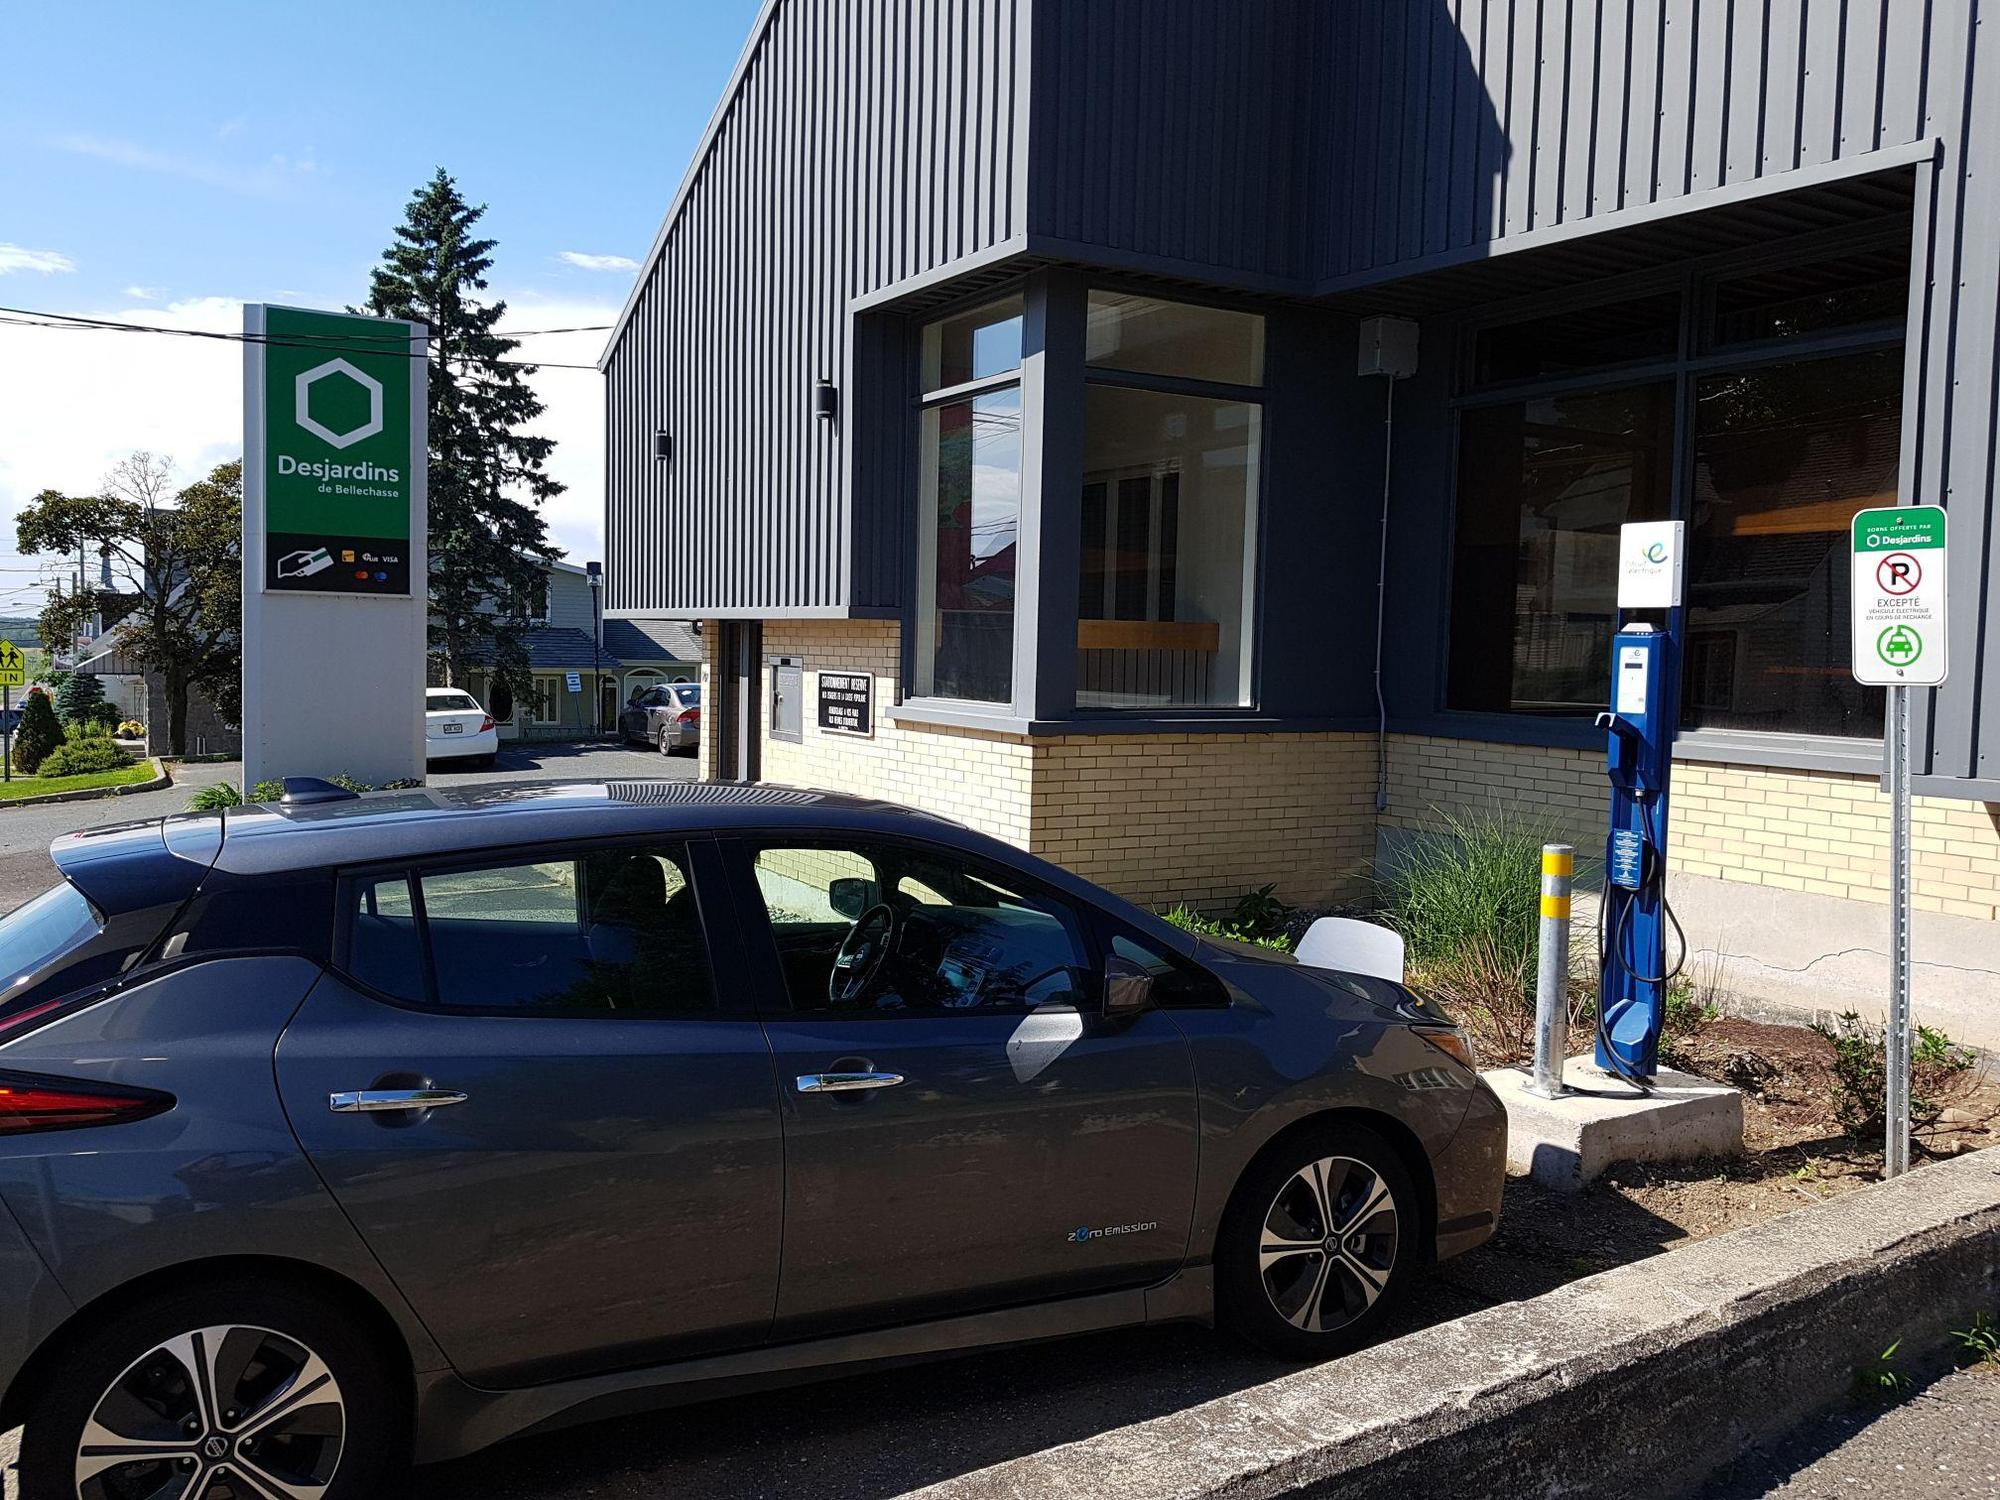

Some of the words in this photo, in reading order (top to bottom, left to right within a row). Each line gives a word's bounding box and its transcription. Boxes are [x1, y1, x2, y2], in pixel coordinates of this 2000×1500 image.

[278, 454, 399, 482] Desjardins
[318, 483, 332, 493] de
[335, 485, 399, 498] Bellechasse
[1882, 534, 1932, 545] Desjardins
[1877, 596, 1920, 607] EXCEPTÉ
[0, 672, 18, 682] IN
